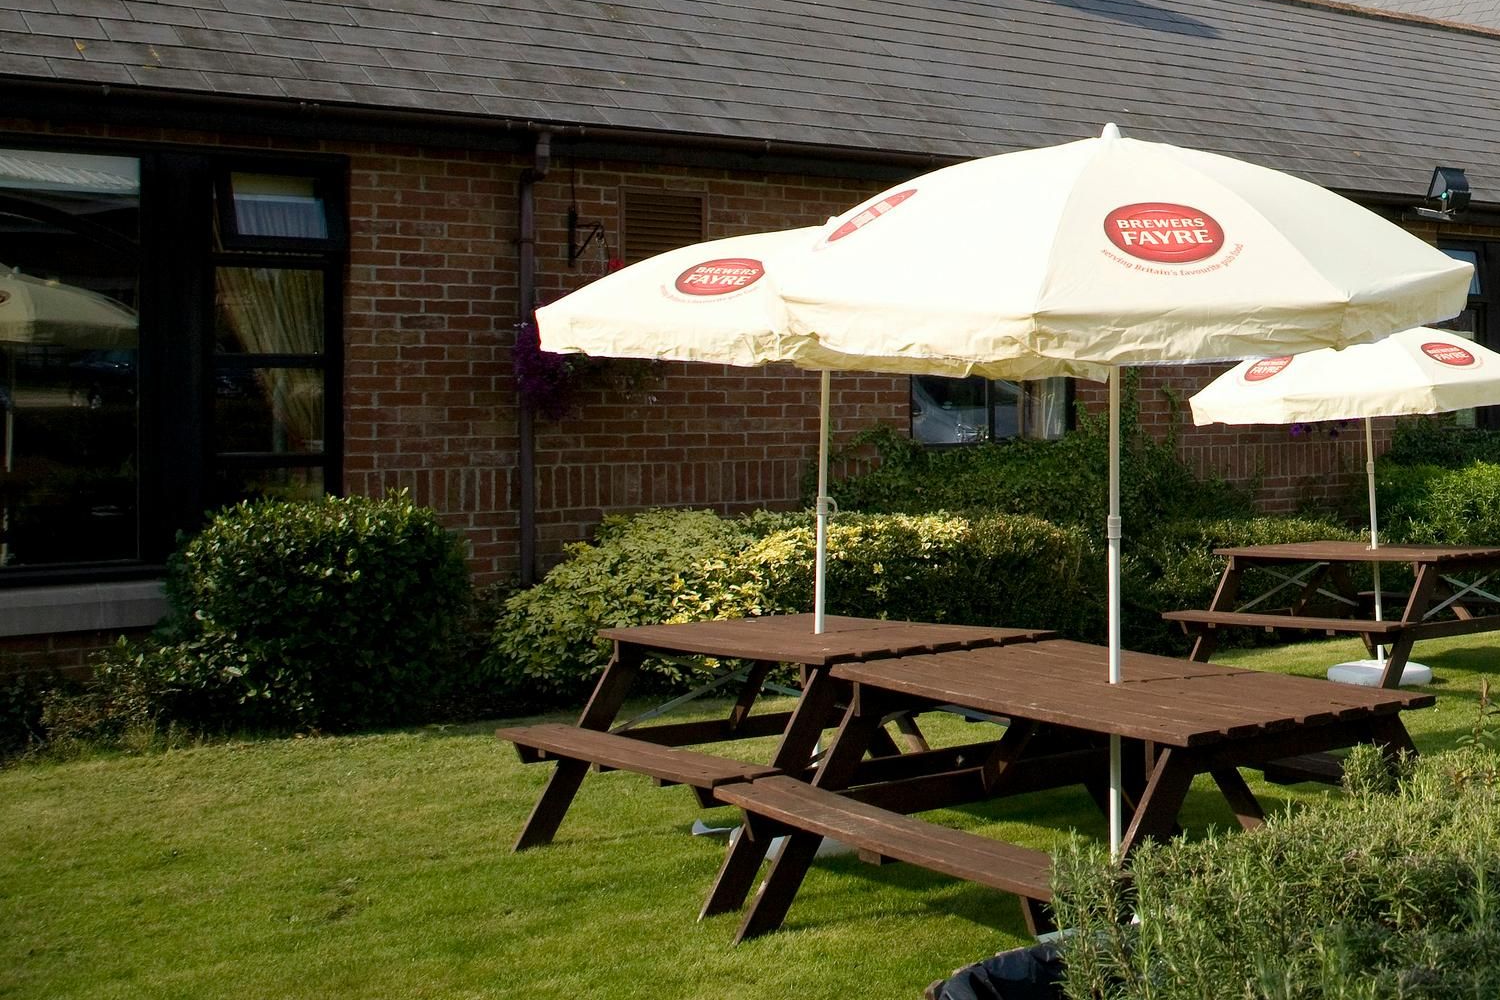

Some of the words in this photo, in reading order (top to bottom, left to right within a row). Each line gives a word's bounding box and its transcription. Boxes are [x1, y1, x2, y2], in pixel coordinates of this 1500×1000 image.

[1116, 218, 1205, 228] BREWERS
[1121, 229, 1213, 245] FAYRE
[1101, 249, 1132, 269] serving
[1135, 264, 1178, 276] Britain's
[695, 266, 759, 275] BREWERS
[684, 273, 751, 286] FAYRE
[1432, 351, 1470, 361] FAYRE
[1250, 365, 1283, 374] FAYRE
